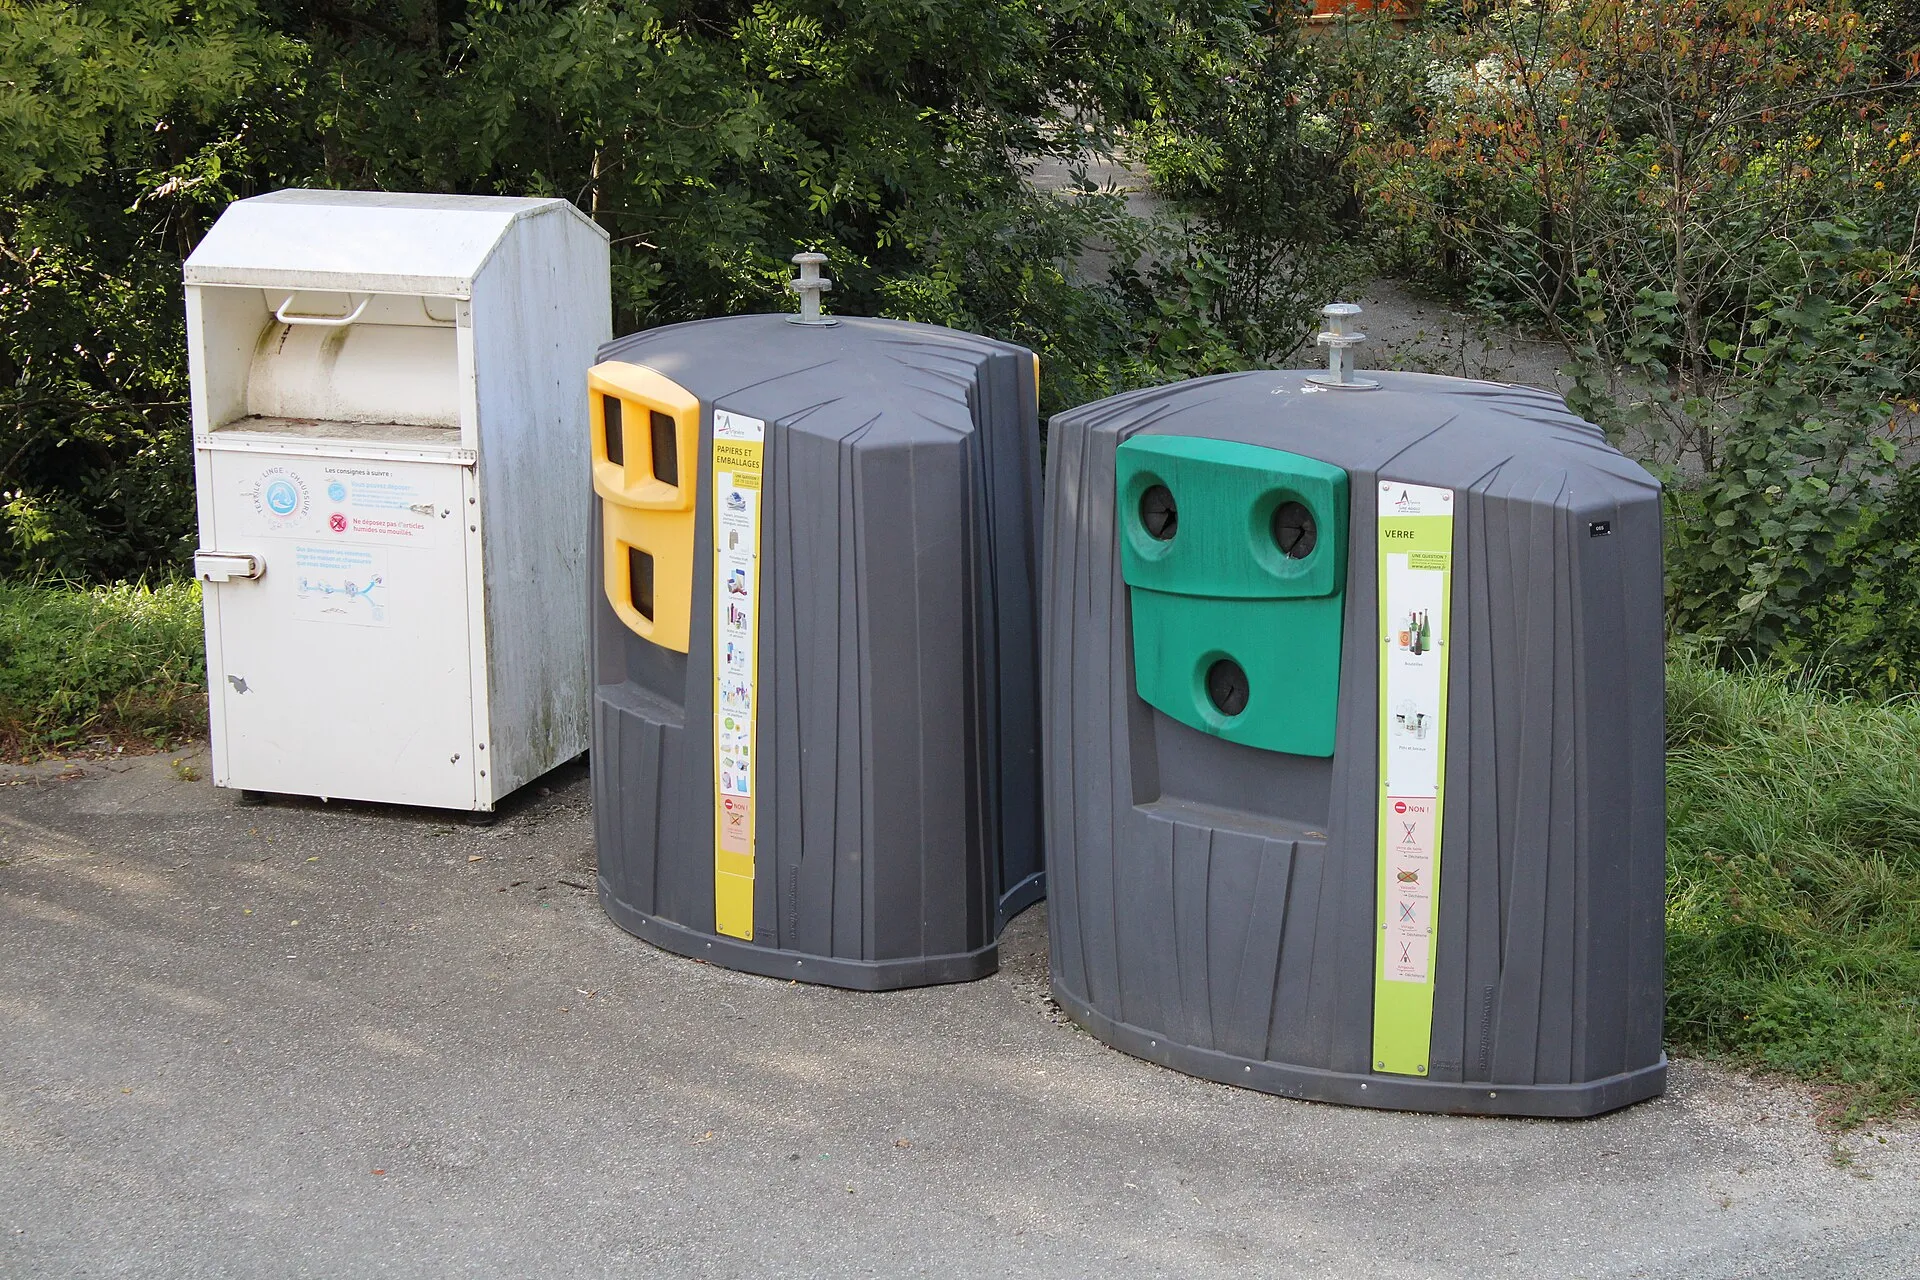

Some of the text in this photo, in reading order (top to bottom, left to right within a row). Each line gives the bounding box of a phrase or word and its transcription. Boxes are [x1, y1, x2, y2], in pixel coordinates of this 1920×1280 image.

[717, 445, 752, 457] PAPIERS ET
[716, 456, 760, 469] EMBALLAGES
[336, 468, 365, 476] consignes
[253, 467, 310, 516] TEXTILE LINGE CHAUSSURE
[362, 518, 386, 527] déposez
[353, 525, 378, 533] humides
[1384, 529, 1415, 539] VERRE
